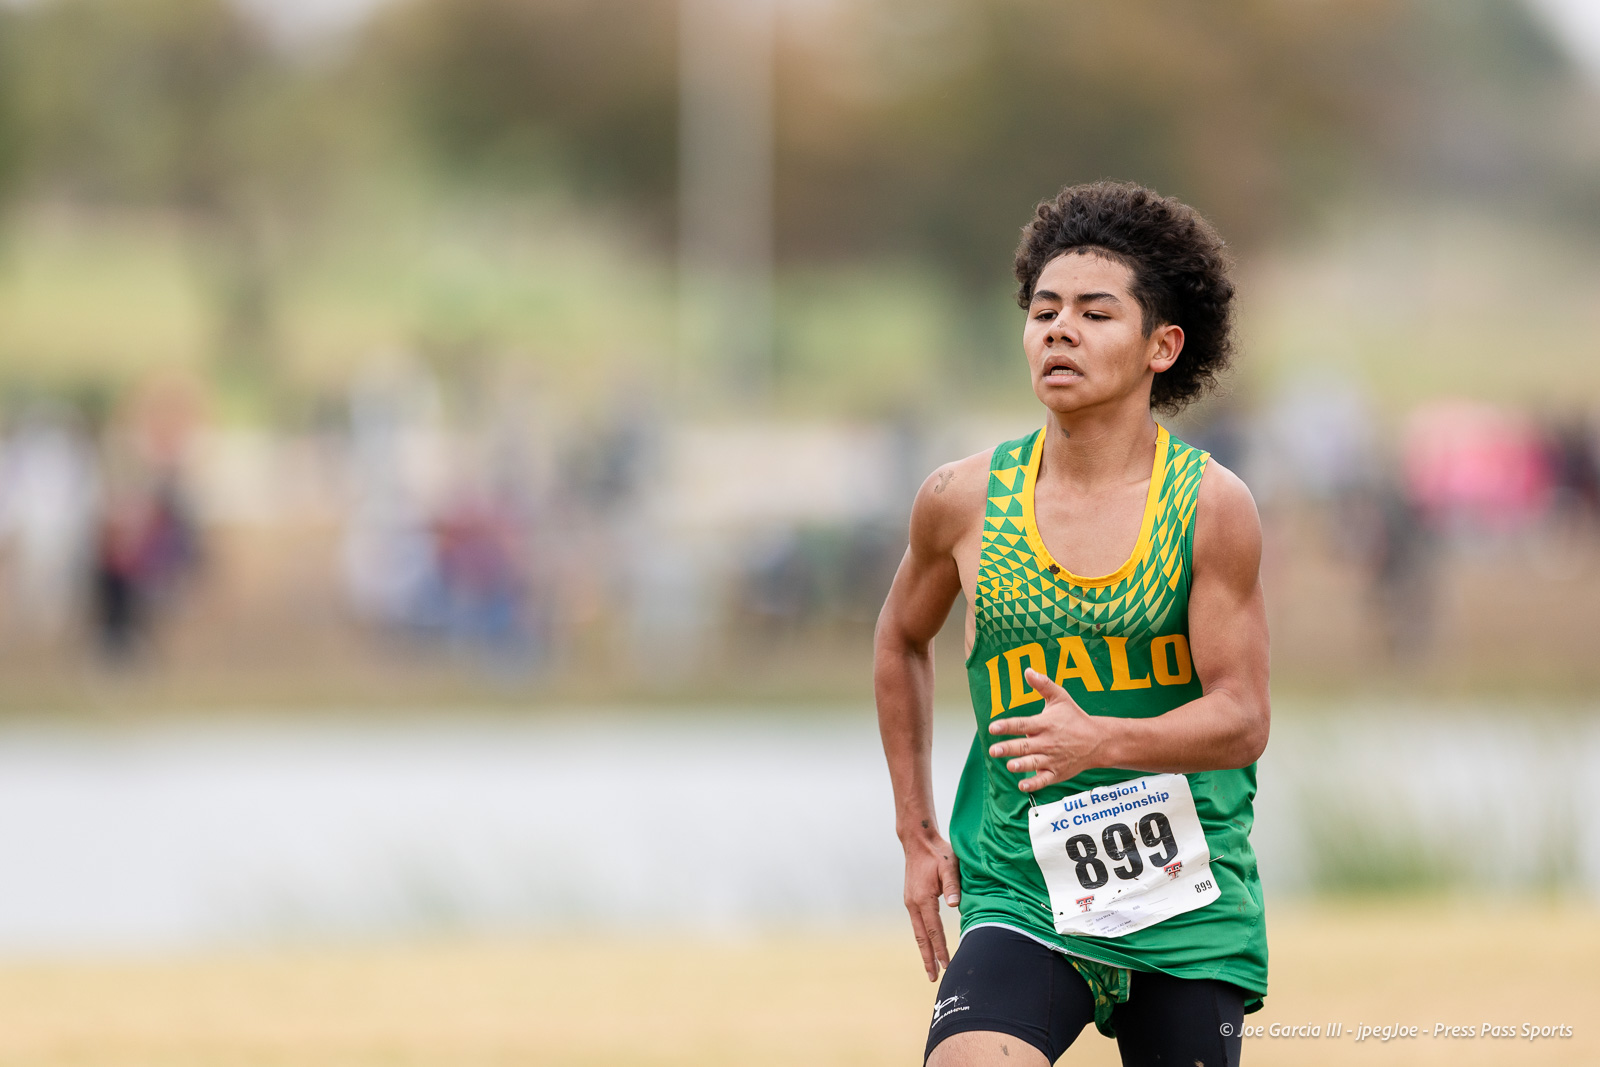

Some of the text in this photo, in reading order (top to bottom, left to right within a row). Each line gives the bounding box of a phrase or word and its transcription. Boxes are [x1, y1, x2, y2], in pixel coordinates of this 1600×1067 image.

[1090, 785, 1139, 805] Region
[1141, 780, 1147, 790] I
[1050, 791, 1170, 833] XC Championship
[1065, 812, 1178, 890] 899
[1194, 879, 1213, 894] 899
